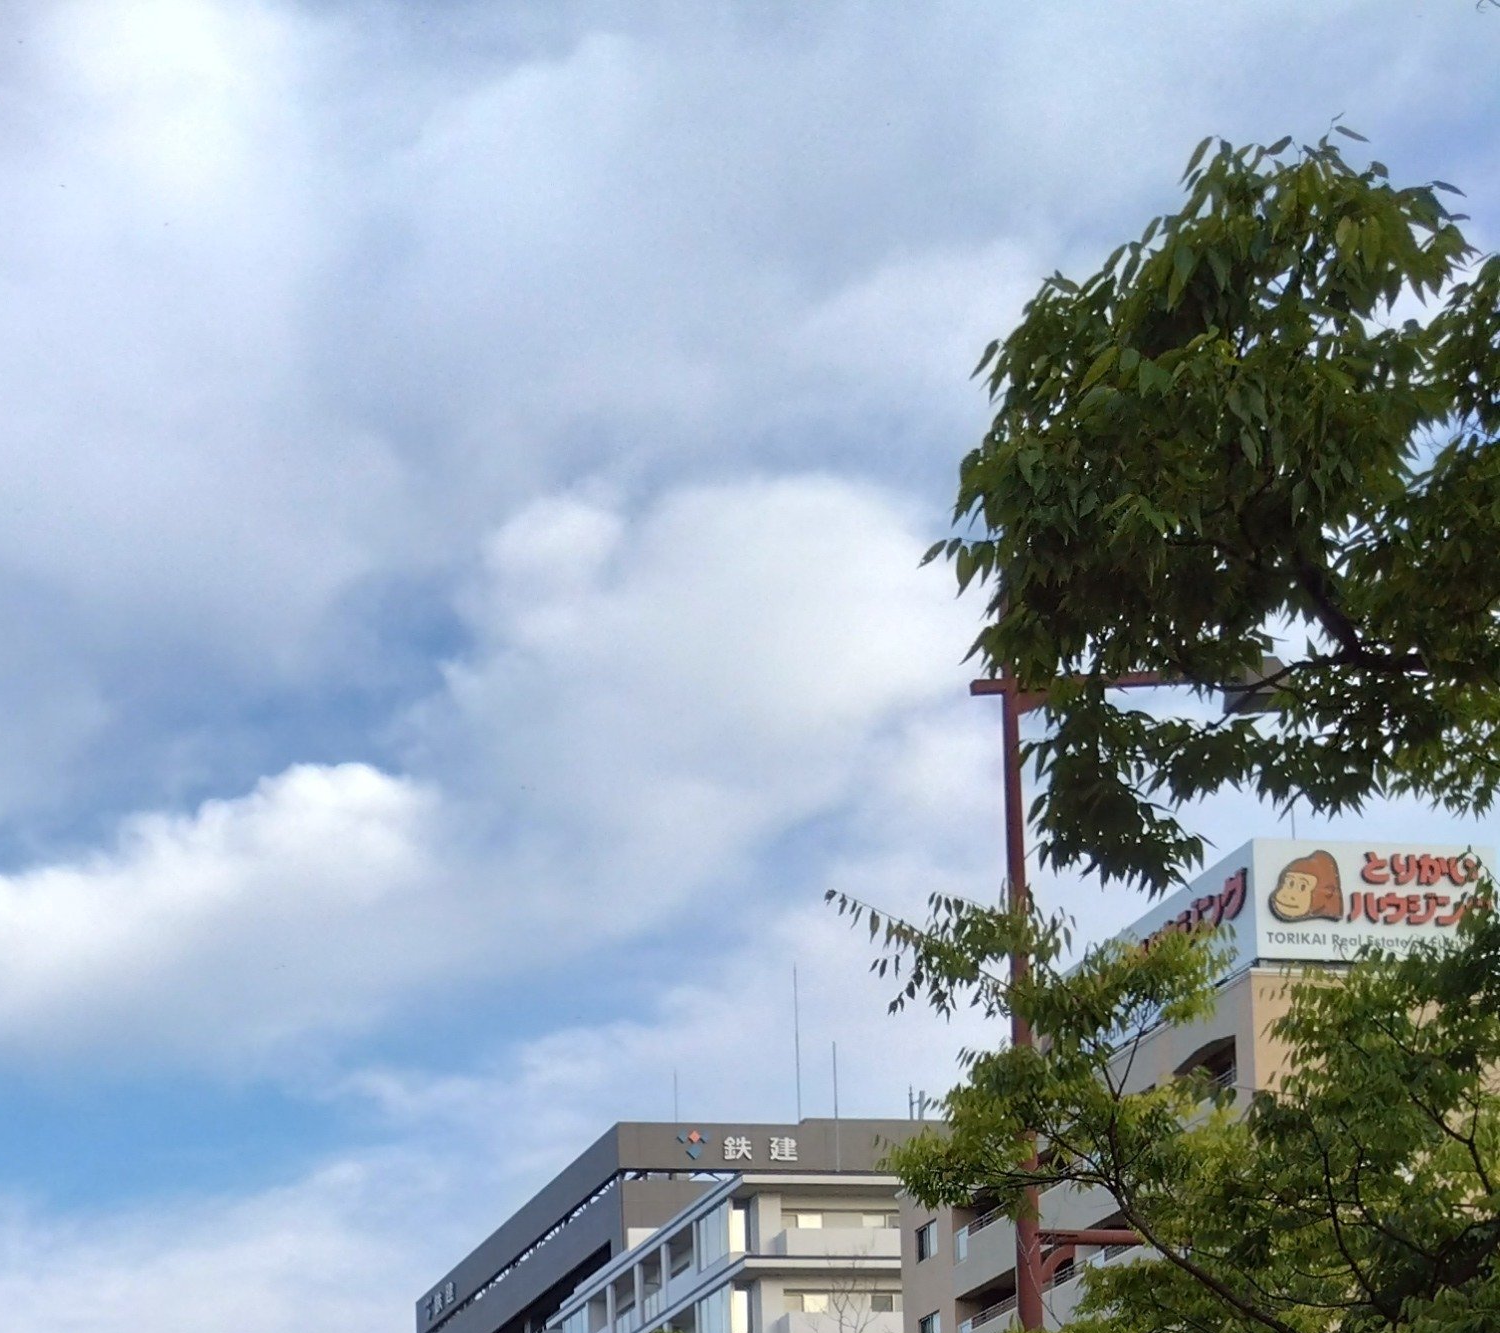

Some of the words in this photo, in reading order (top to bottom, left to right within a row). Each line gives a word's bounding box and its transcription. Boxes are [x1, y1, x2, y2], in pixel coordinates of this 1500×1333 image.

[1266, 931, 1327, 946] TORIKAI
[1331, 934, 1362, 948] Real
[723, 1136, 799, 1161] 鉄建
